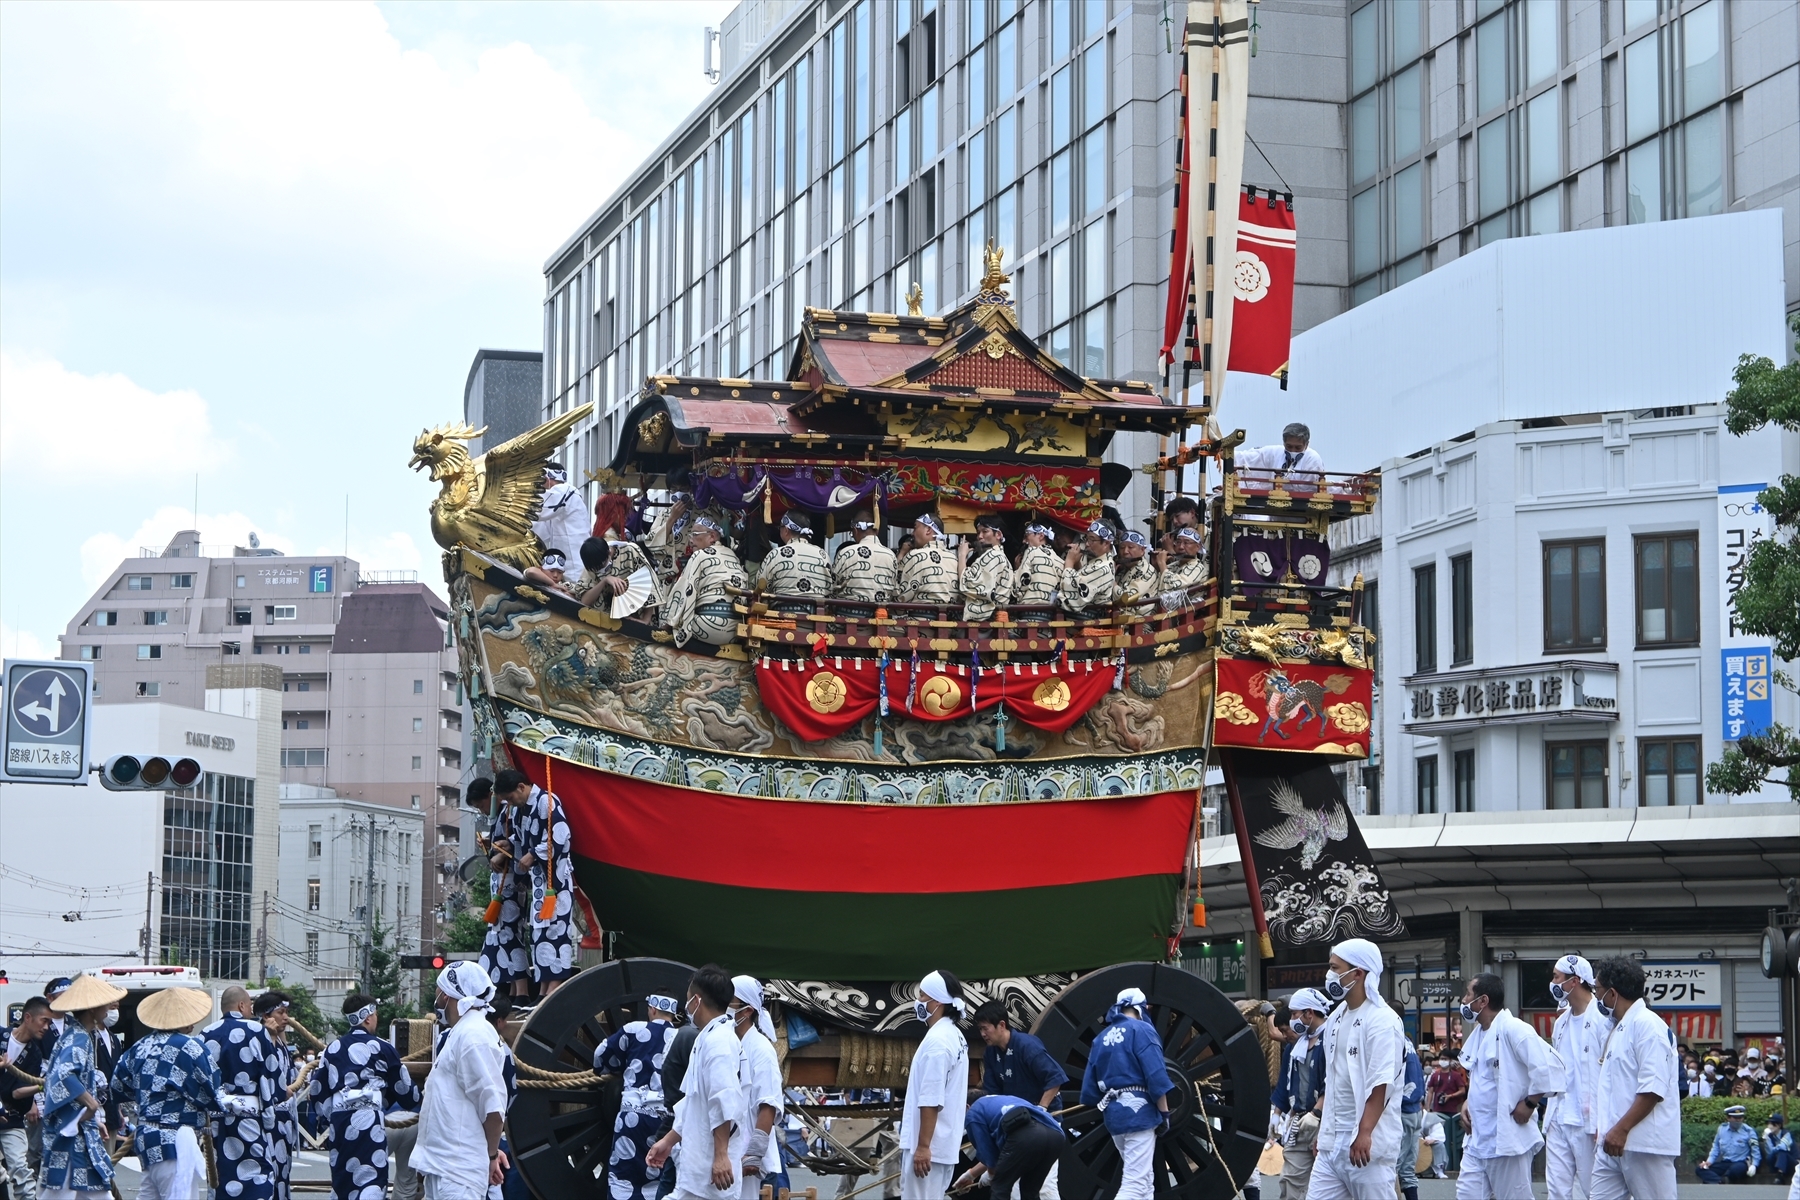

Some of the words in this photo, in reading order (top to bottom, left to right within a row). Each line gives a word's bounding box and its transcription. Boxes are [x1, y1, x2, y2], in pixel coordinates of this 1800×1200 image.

[258, 568, 305, 577] エステムコート
[264, 577, 300, 585] 京都河原町
[1725, 528, 1746, 638] コンタト
[1747, 657, 1766, 698] すぐ
[1411, 675, 1563, 719] 池善化粧品店
[1725, 656, 1745, 738] 買えます
[211, 735, 236, 752] SEED
[9, 747, 79, 765] 路線バスを除く
[1644, 969, 1706, 979] メガネスーパー
[1644, 983, 1706, 1001] タクト
